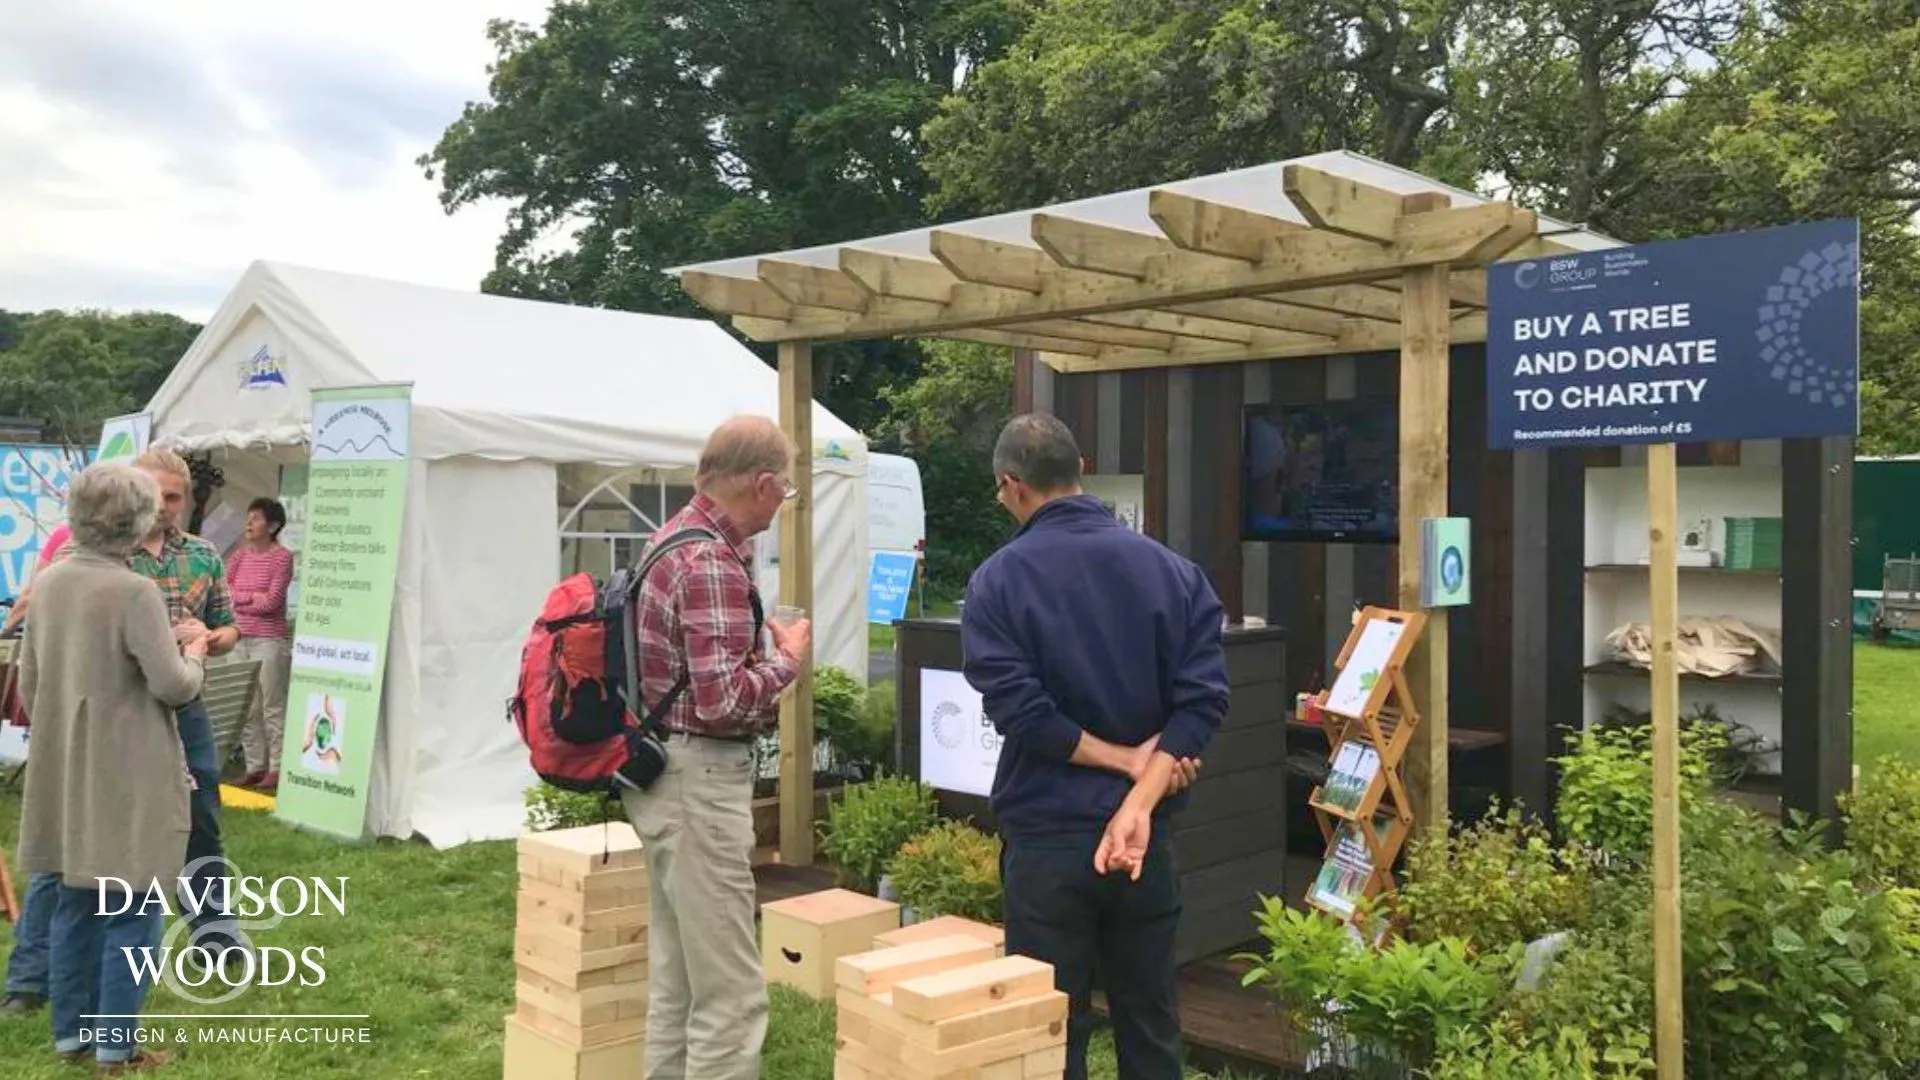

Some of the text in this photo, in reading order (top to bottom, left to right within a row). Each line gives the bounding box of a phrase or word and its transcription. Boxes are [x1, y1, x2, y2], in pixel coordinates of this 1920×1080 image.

[1550, 259, 1579, 271] BSW
[1550, 268, 1597, 284] GROUP
[1514, 303, 1690, 341] BUY A TREE
[1514, 339, 1717, 376] AND DONATE
[1513, 378, 1708, 411] TO CHARITY
[1514, 422, 1692, 440] Recommended donation of £5
[287, 772, 356, 798] Transition Network
